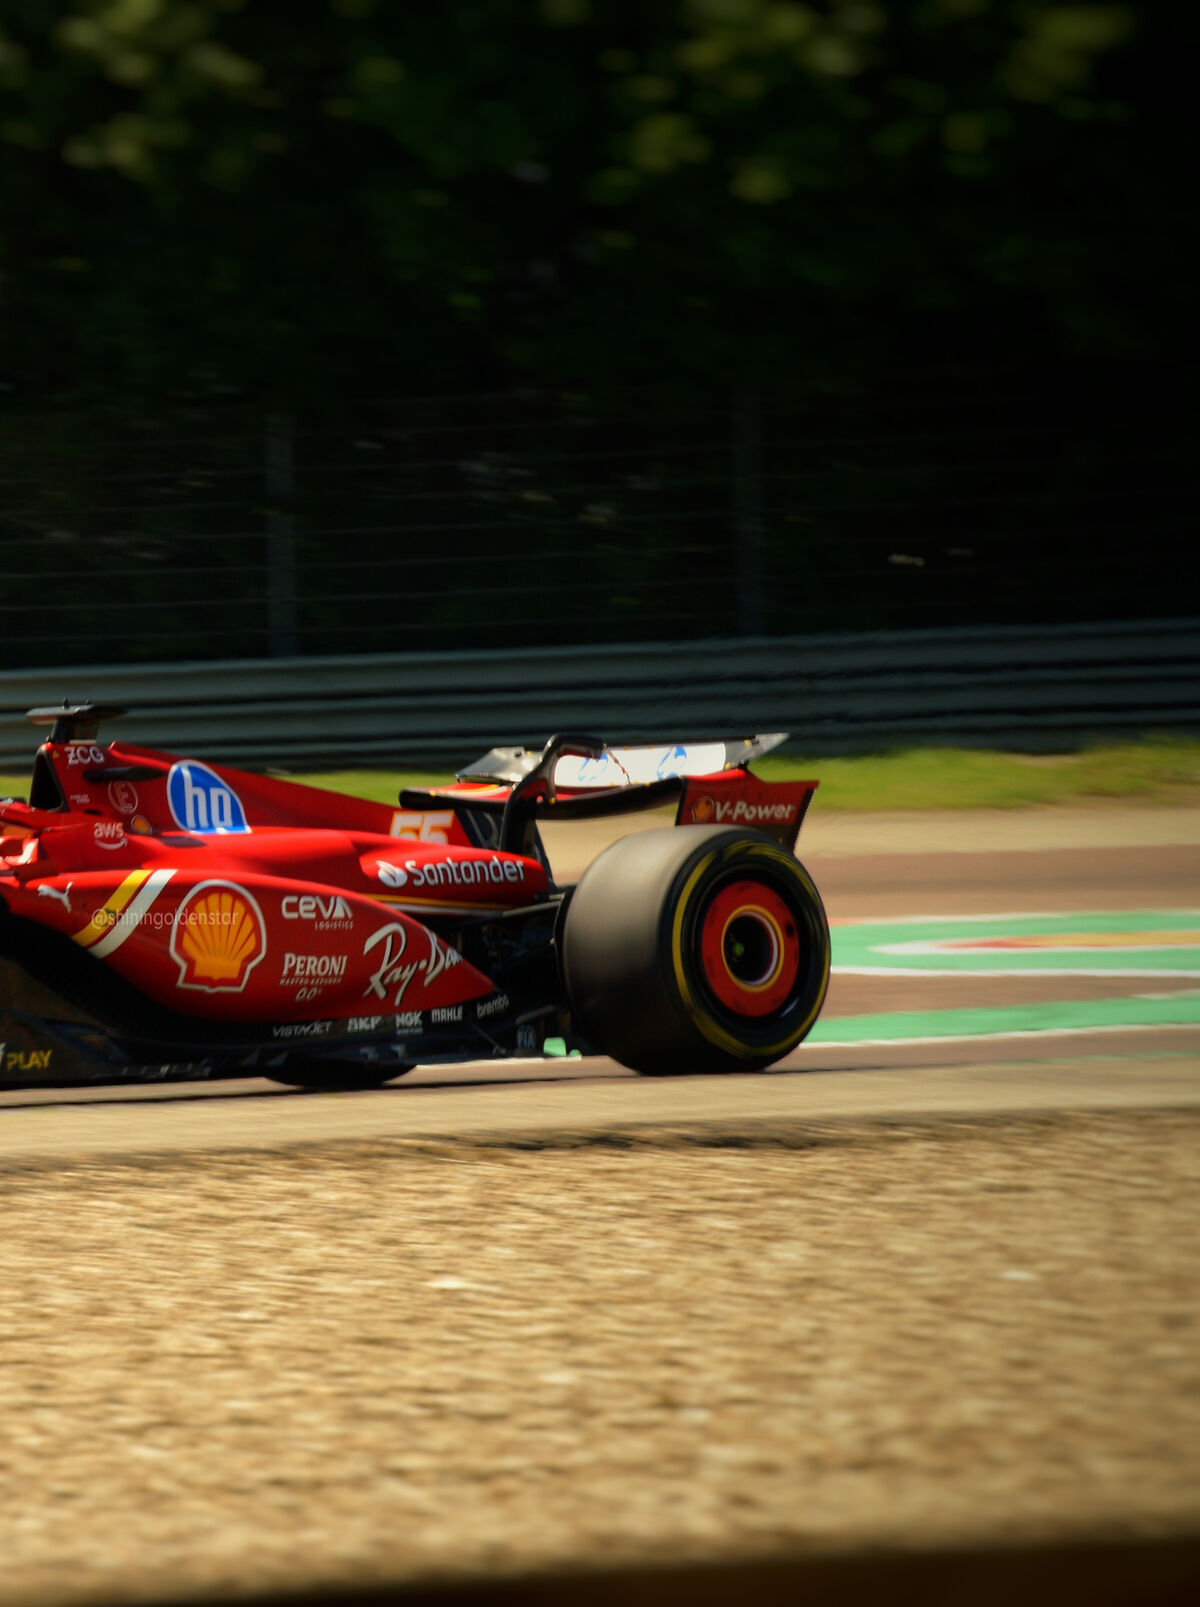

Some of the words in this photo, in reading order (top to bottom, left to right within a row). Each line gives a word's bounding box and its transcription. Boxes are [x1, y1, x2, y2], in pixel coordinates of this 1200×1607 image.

[64, 746, 105, 765] ZCG
[715, 801, 796, 821] V-Power
[94, 822, 125, 839] aws
[389, 810, 455, 845] 55
[404, 855, 525, 887] Santander
[314, 920, 355, 931] LOGISTICS
[282, 952, 349, 977] PERONI
[431, 1006, 463, 1023] MAHLE
[6, 1049, 52, 1070] PLAY
